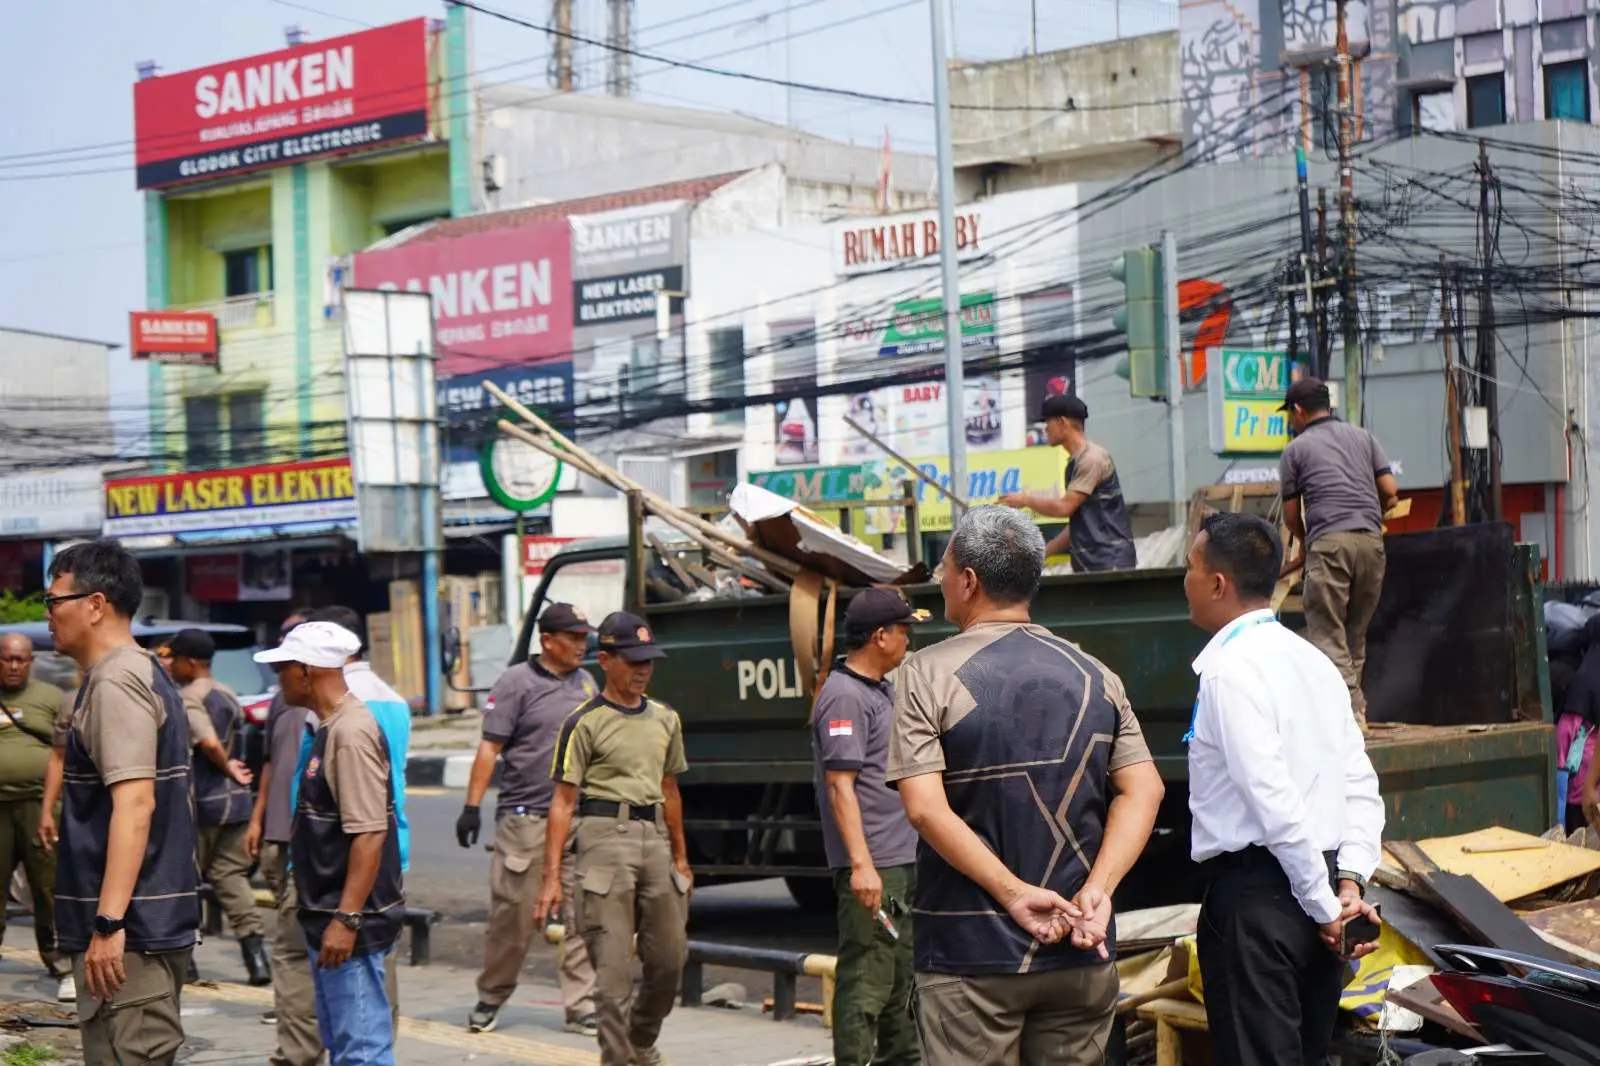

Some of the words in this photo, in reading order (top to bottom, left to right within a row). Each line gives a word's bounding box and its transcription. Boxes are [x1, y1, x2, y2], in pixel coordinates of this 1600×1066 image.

[195, 46, 354, 119] SANKEN
[180, 151, 240, 176] GLODOK
[243, 142, 280, 164] CITY
[283, 123, 382, 157] ELECTRONIC
[575, 215, 670, 252] SANKEN
[844, 223, 917, 266] RUMAH
[923, 212, 981, 257] BBY
[378, 258, 552, 320] NKEN
[582, 281, 616, 299] NEW
[618, 273, 664, 295] LASER
[904, 384, 940, 403] BABY
[107, 485, 158, 517] NEW
[165, 476, 246, 512] LASER
[916, 463, 1021, 502] Prma
[1225, 468, 1280, 484] SEPEDA
[738, 658, 804, 699] POLI
